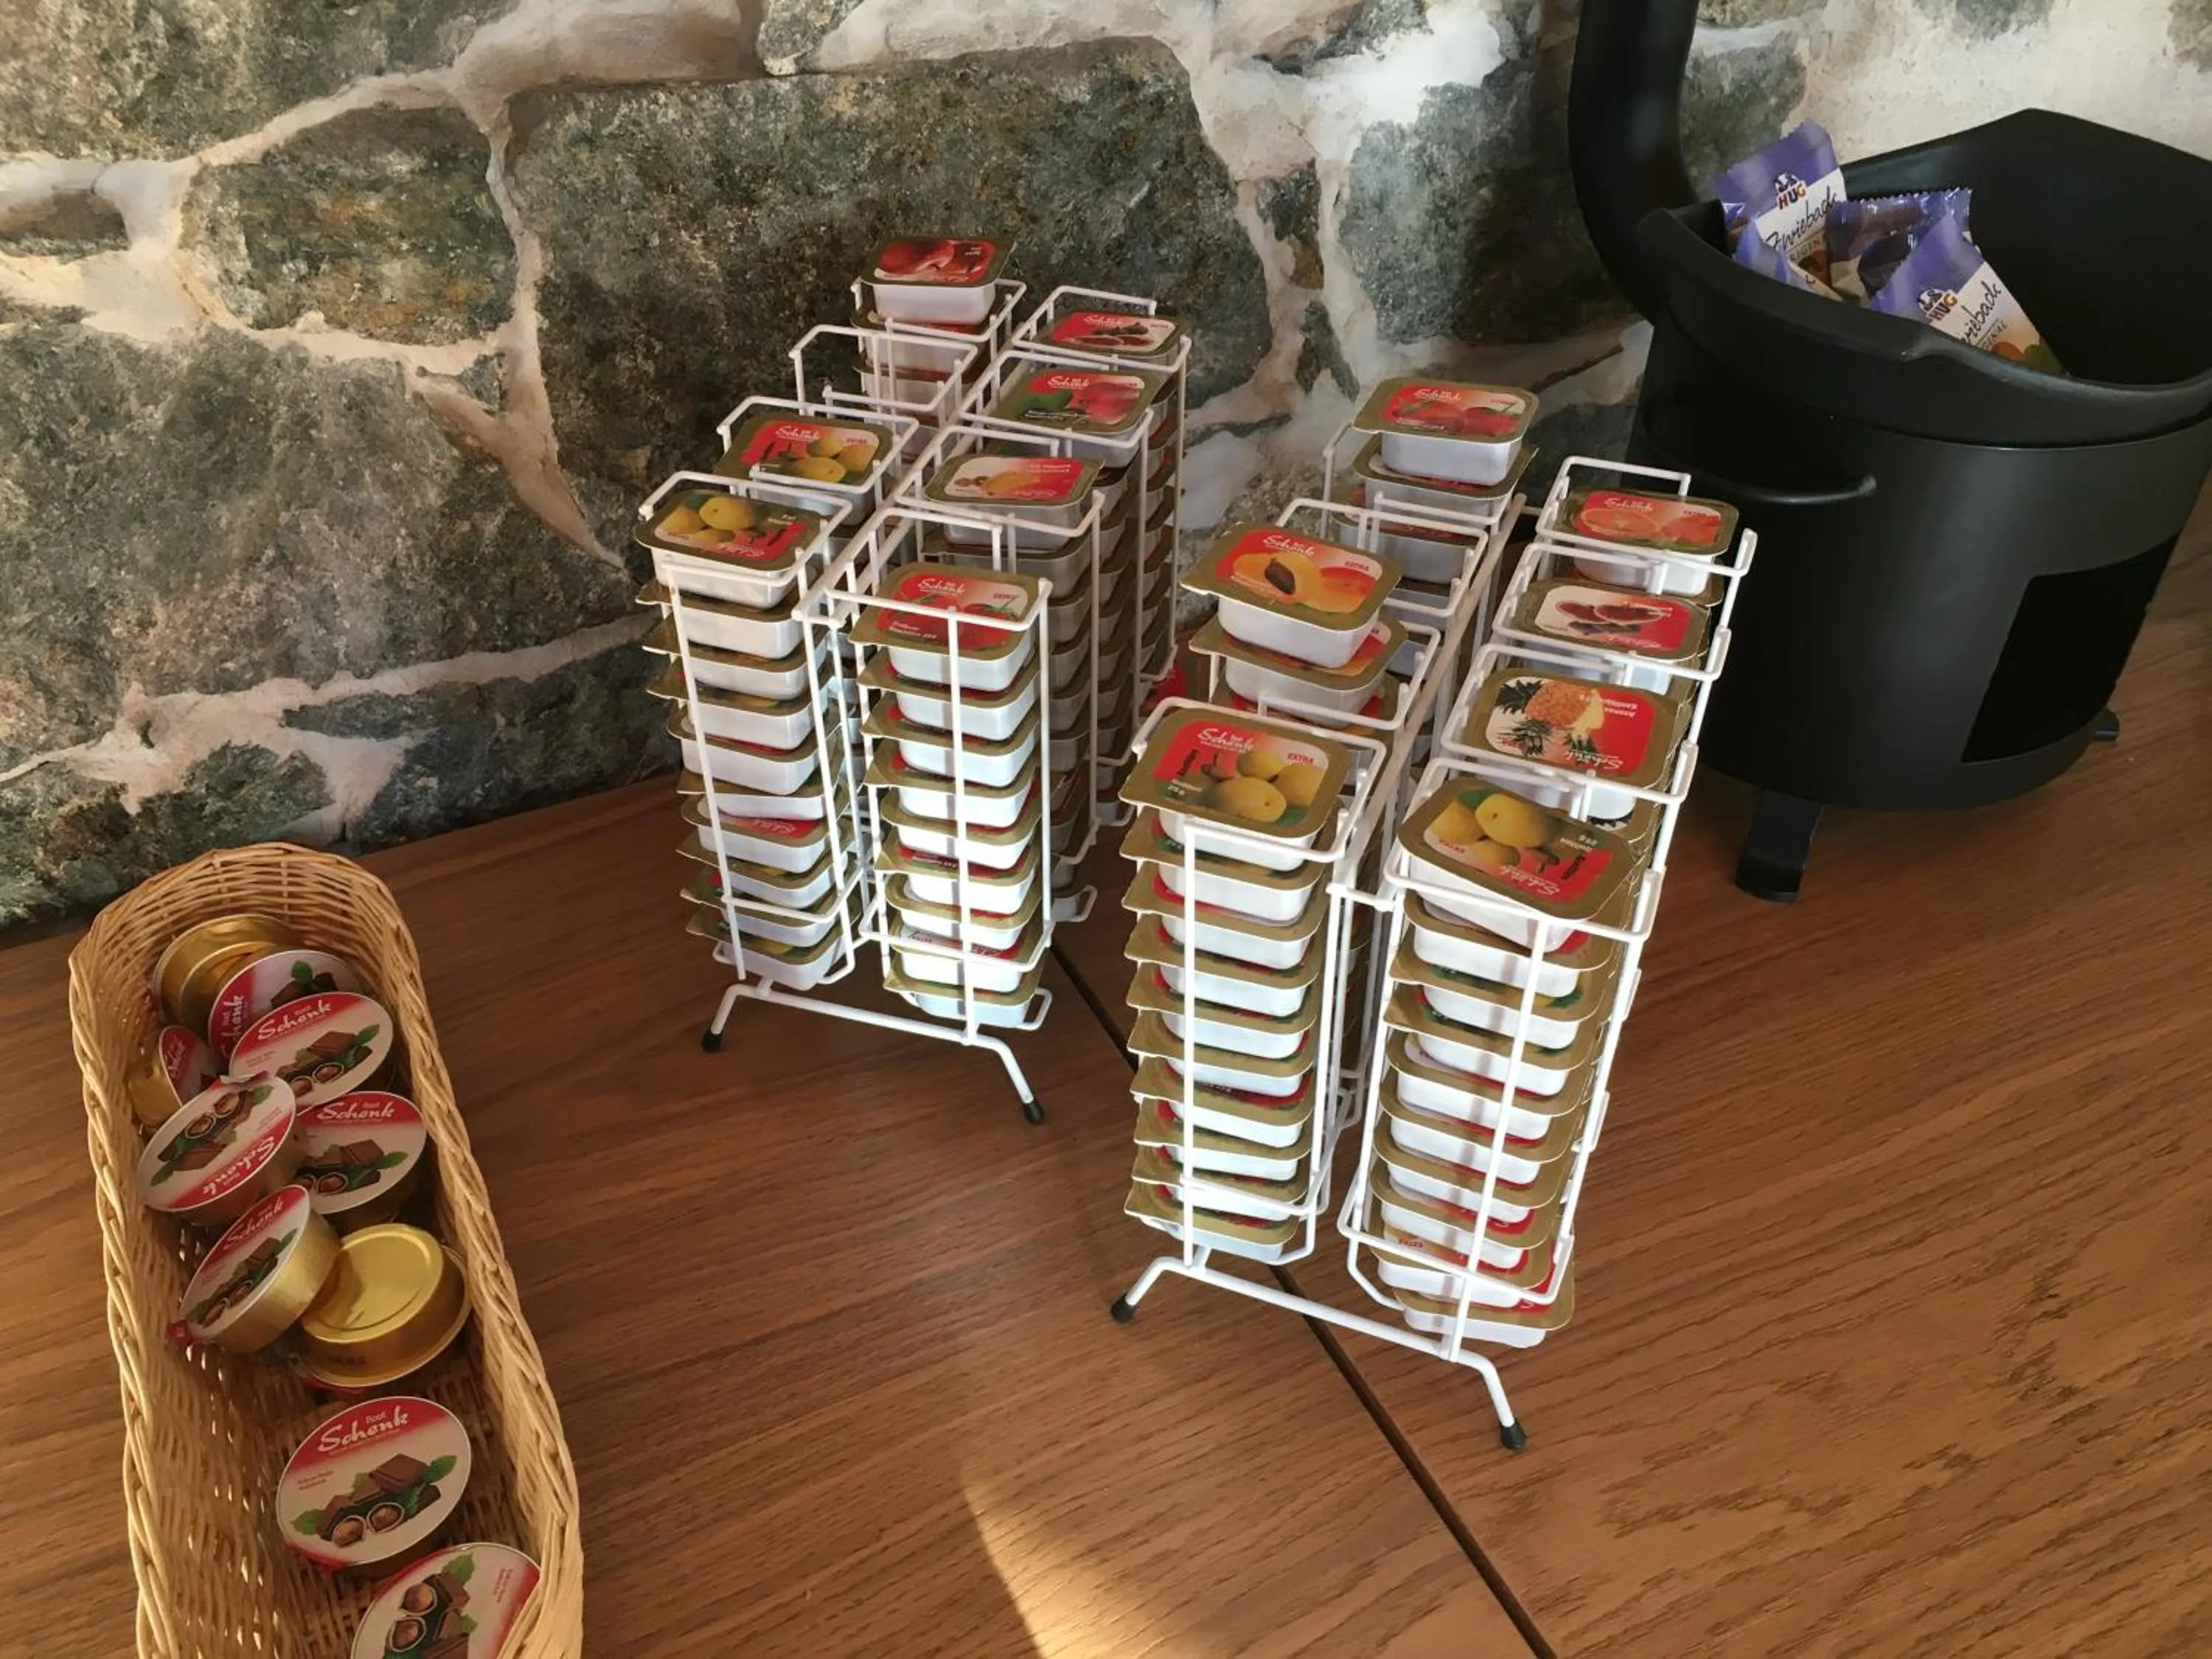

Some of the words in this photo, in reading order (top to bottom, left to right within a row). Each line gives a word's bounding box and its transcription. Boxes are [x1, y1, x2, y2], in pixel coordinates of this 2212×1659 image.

[1778, 183, 1806, 210] HUG
[1927, 292, 1958, 321] HUG
[1344, 560, 1371, 572] EXTRA
[1287, 752, 1315, 765] EXTRA
[257, 999, 331, 1040] Schenk
[316, 1100, 395, 1120] Schenk
[202, 1135, 276, 1197] Schenk
[317, 1404, 409, 1453] Schenk
